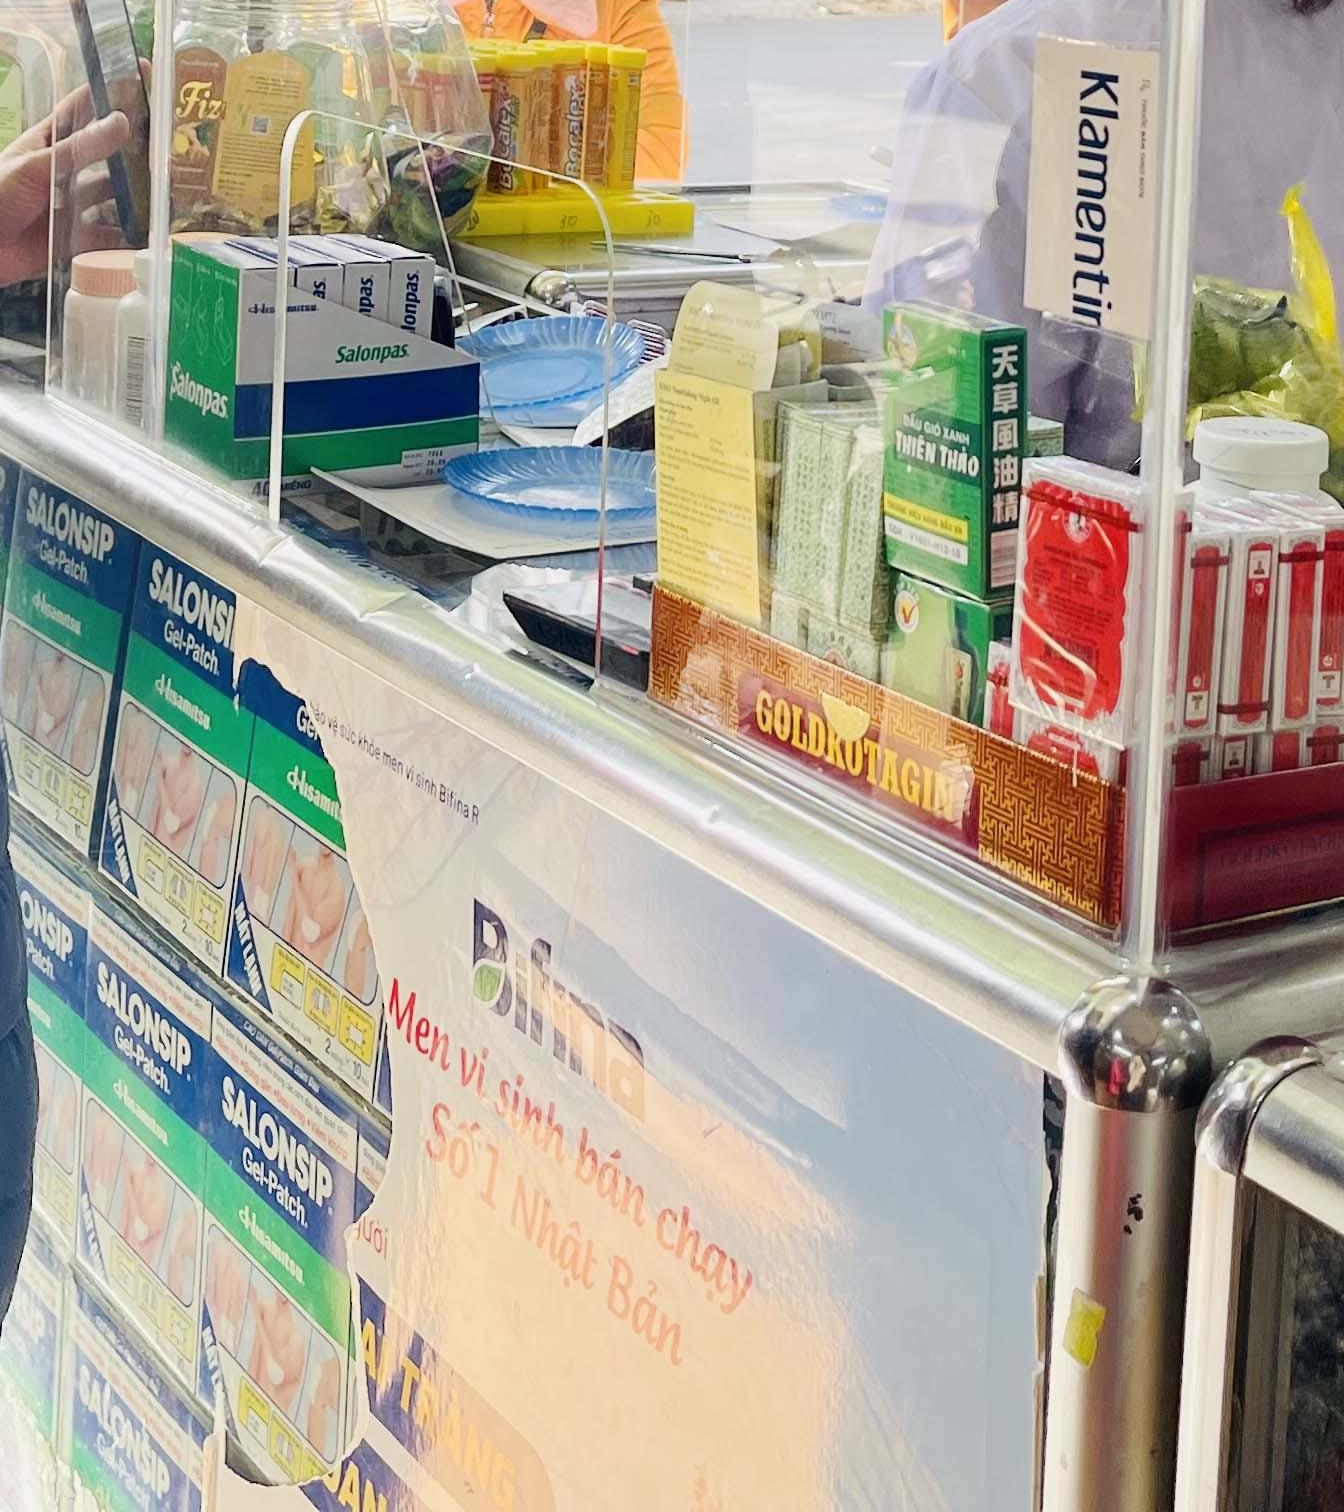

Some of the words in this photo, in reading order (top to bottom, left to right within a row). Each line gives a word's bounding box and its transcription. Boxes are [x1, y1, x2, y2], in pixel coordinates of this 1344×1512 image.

[175, 79, 227, 121] Fiz
[335, 343, 408, 364] Salonpas
[169, 360, 229, 420] Salonpas
[894, 429, 938, 464] THIÊN
[991, 343, 1020, 526] 天草風油精
[26, 486, 115, 562] SALONSIP
[39, 539, 88, 584] Gel-Patch
[163, 619, 219, 677] Gel-Patch
[156, 673, 211, 731] Hisamitsu
[382, 750, 404, 777] men
[405, 760, 415, 782] vi
[415, 770, 438, 799] sinh
[438, 782, 470, 820] Bifina
[96, 961, 192, 1076] SALONSIP
[113, 1025, 171, 1096] Gel-Patch
[221, 1075, 334, 1209] SALONSIP
[386, 977, 453, 1074] Men
[460, 1043, 490, 1095] vi
[493, 1069, 568, 1164] sinh
[574, 1129, 649, 1230] bán
[653, 1202, 755, 1318] chạy
[241, 1146, 308, 1228] Gel-Patch
[423, 1098, 480, 1185] Số
[479, 1142, 500, 1208] 1
[509, 1180, 601, 1294] Nhật
[607, 1252, 684, 1368] Bản
